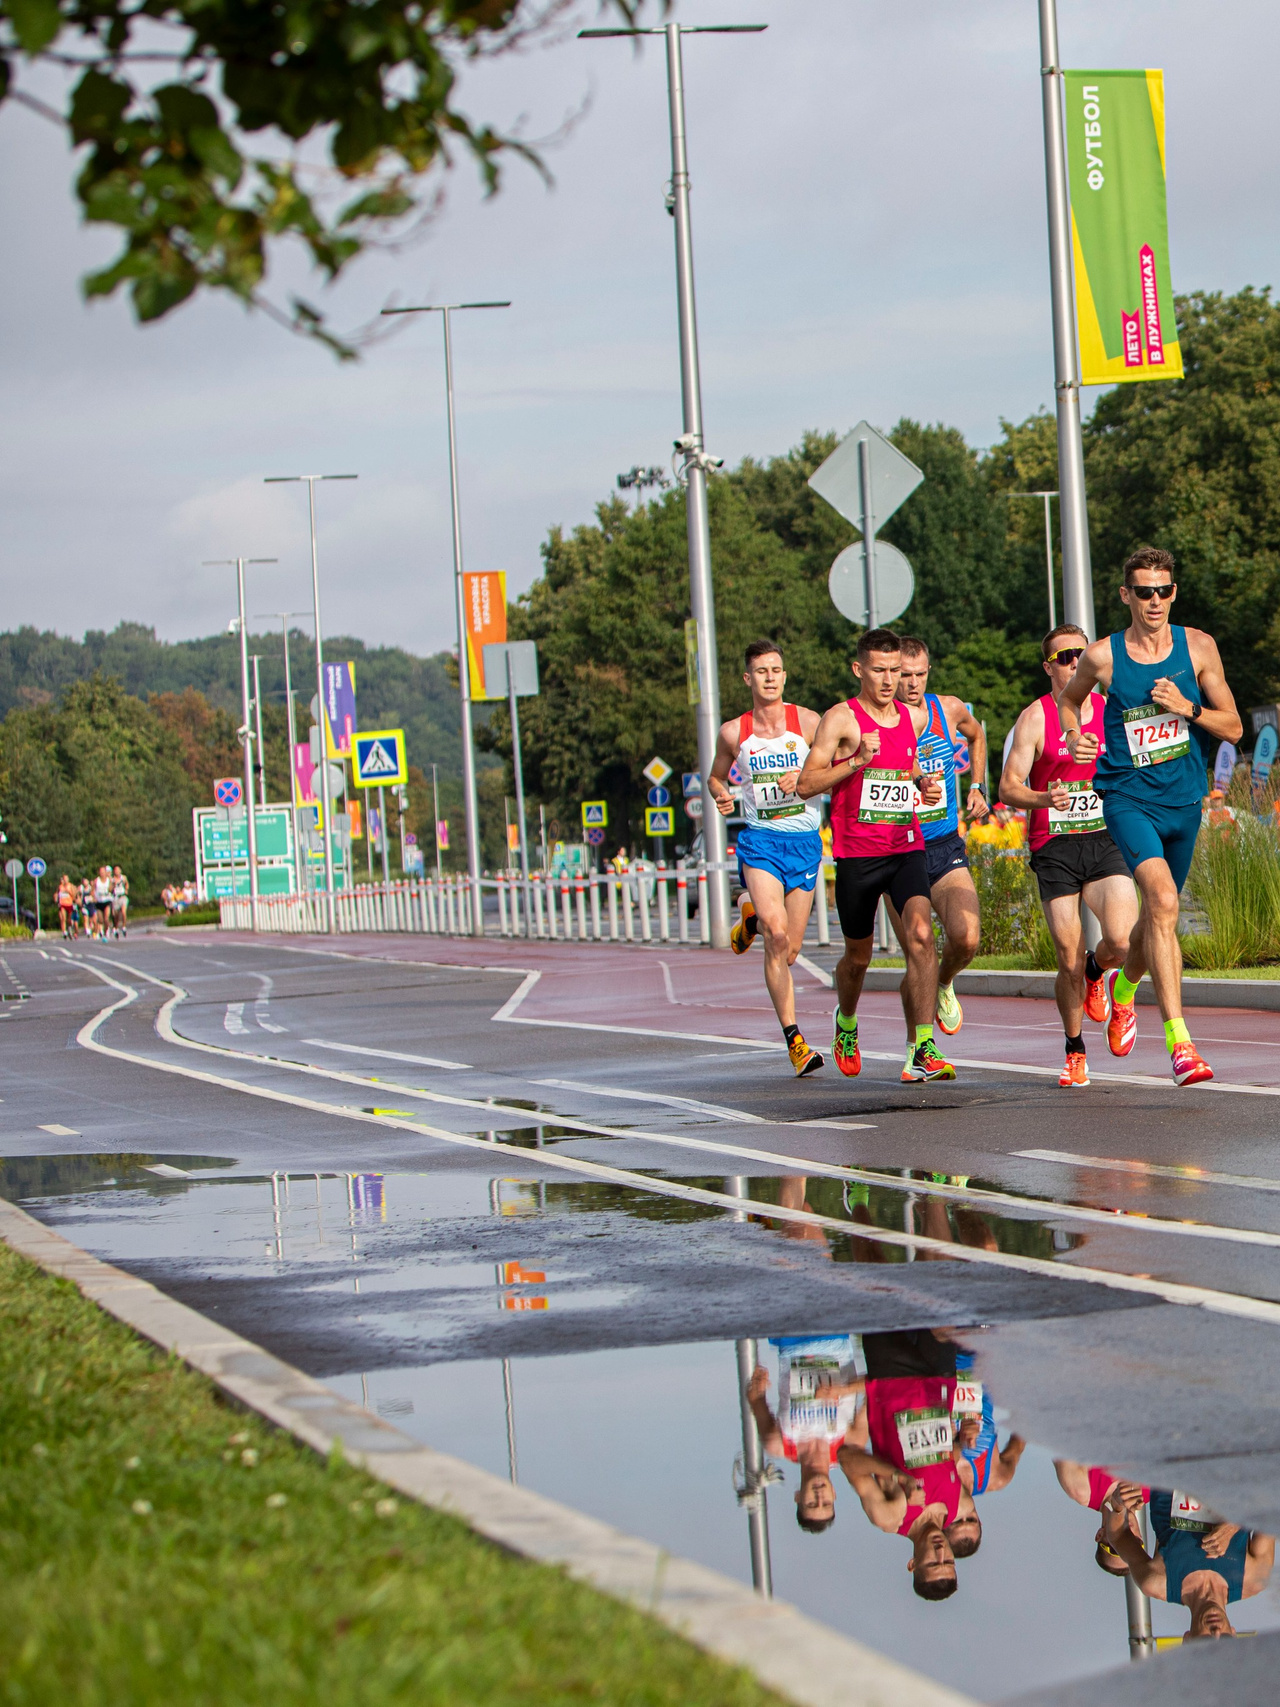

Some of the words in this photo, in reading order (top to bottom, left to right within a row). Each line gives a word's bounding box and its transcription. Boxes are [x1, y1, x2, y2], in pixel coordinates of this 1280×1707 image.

[1083, 85, 1104, 191] ФУТБОЛ
[1142, 254, 1160, 347] ЛУЖНИКАХ
[1125, 319, 1140, 363] ЛЕТО
[1150, 350, 1162, 362] В
[471, 575, 482, 633] ЗДОРОВЬЕ
[481, 575, 491, 625] КРАСОТА
[1134, 719, 1179, 746] 7247
[749, 752, 799, 772] RUSSIA
[1141, 754, 1149, 764] A
[869, 785, 909, 802] 5730
[1069, 794, 1098, 812] 732
[863, 811, 872, 820] A
[1054, 823, 1062, 832] A
